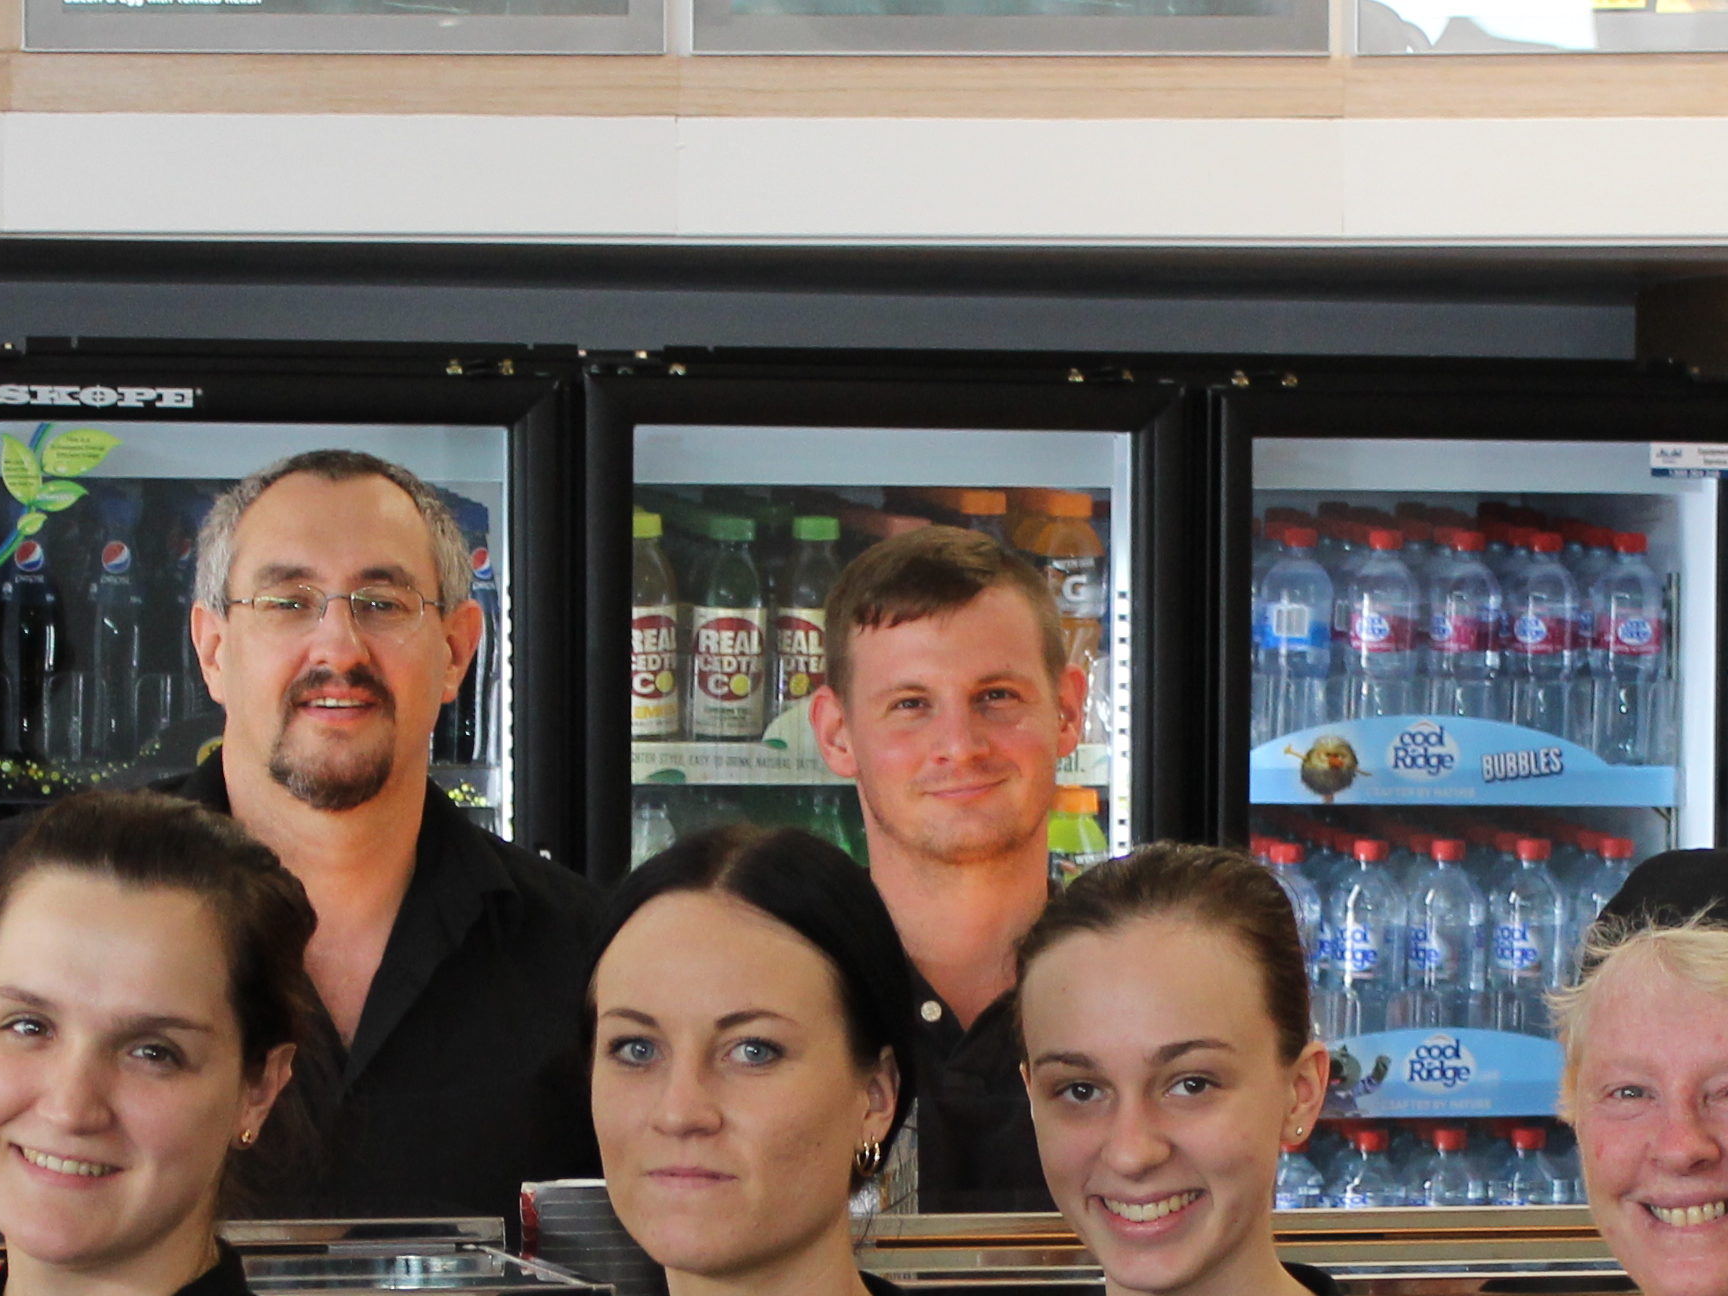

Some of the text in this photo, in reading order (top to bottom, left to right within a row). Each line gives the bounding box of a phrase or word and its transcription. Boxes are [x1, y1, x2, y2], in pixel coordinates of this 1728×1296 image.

[1400, 726, 1445, 747] cool
[1392, 746, 1454, 776] Ridge
[1482, 748, 1564, 783] BUBBLES
[1416, 1038, 1461, 1060] cool
[1408, 1059, 1470, 1087] Ridge
